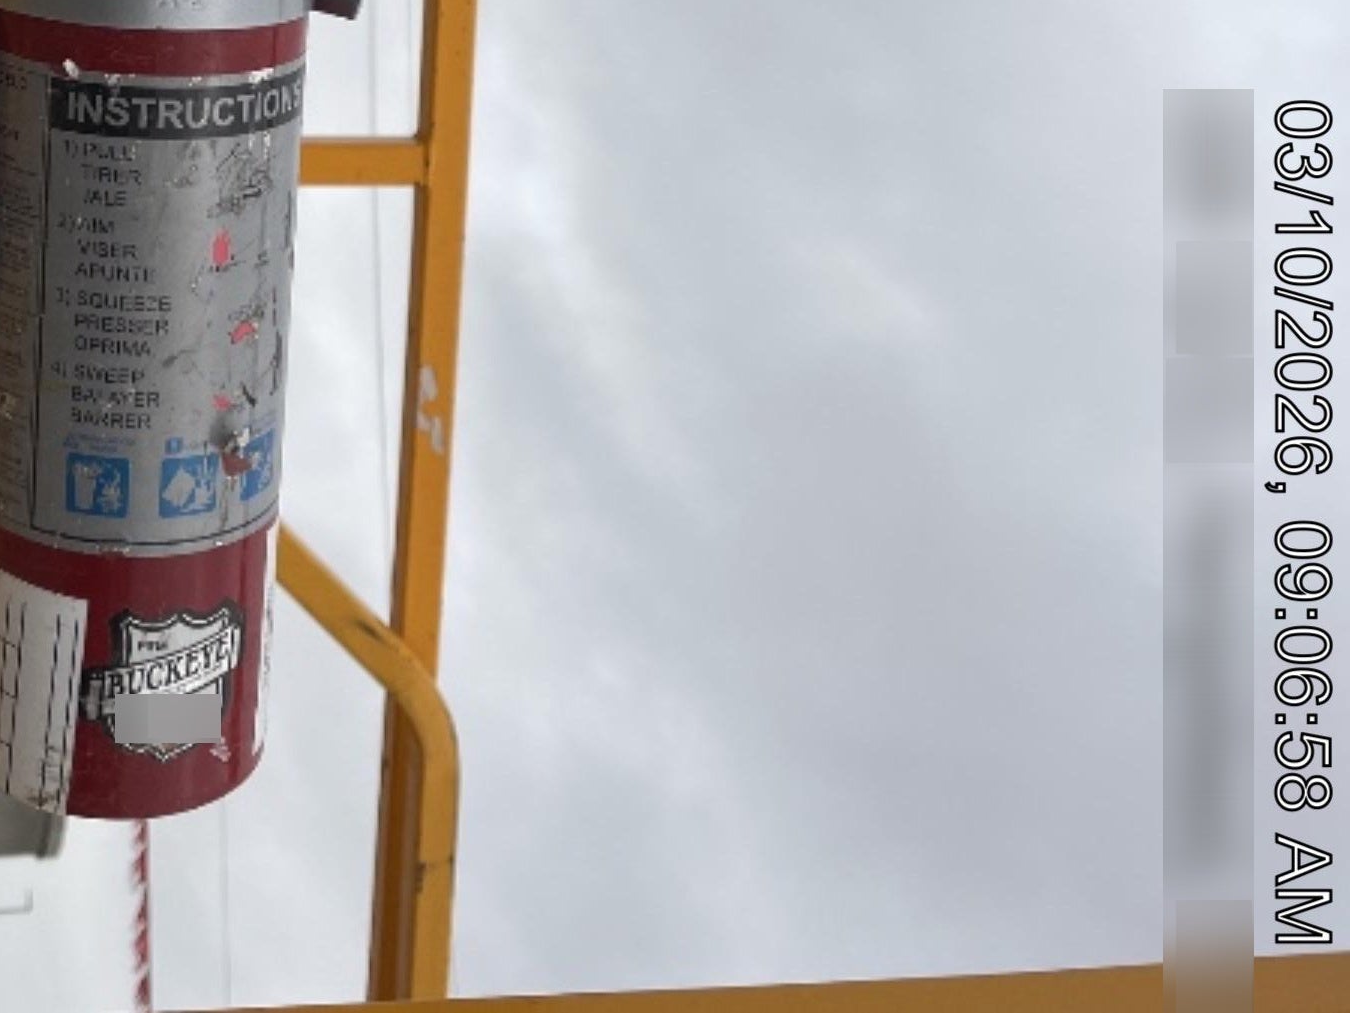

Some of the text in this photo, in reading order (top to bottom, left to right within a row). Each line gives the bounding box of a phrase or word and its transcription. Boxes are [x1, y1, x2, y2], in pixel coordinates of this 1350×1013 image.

[67, 79, 302, 130] INSTRUCTIONS
[71, 385, 160, 408] BAAYER
[106, 631, 230, 699] BUCKEYE
